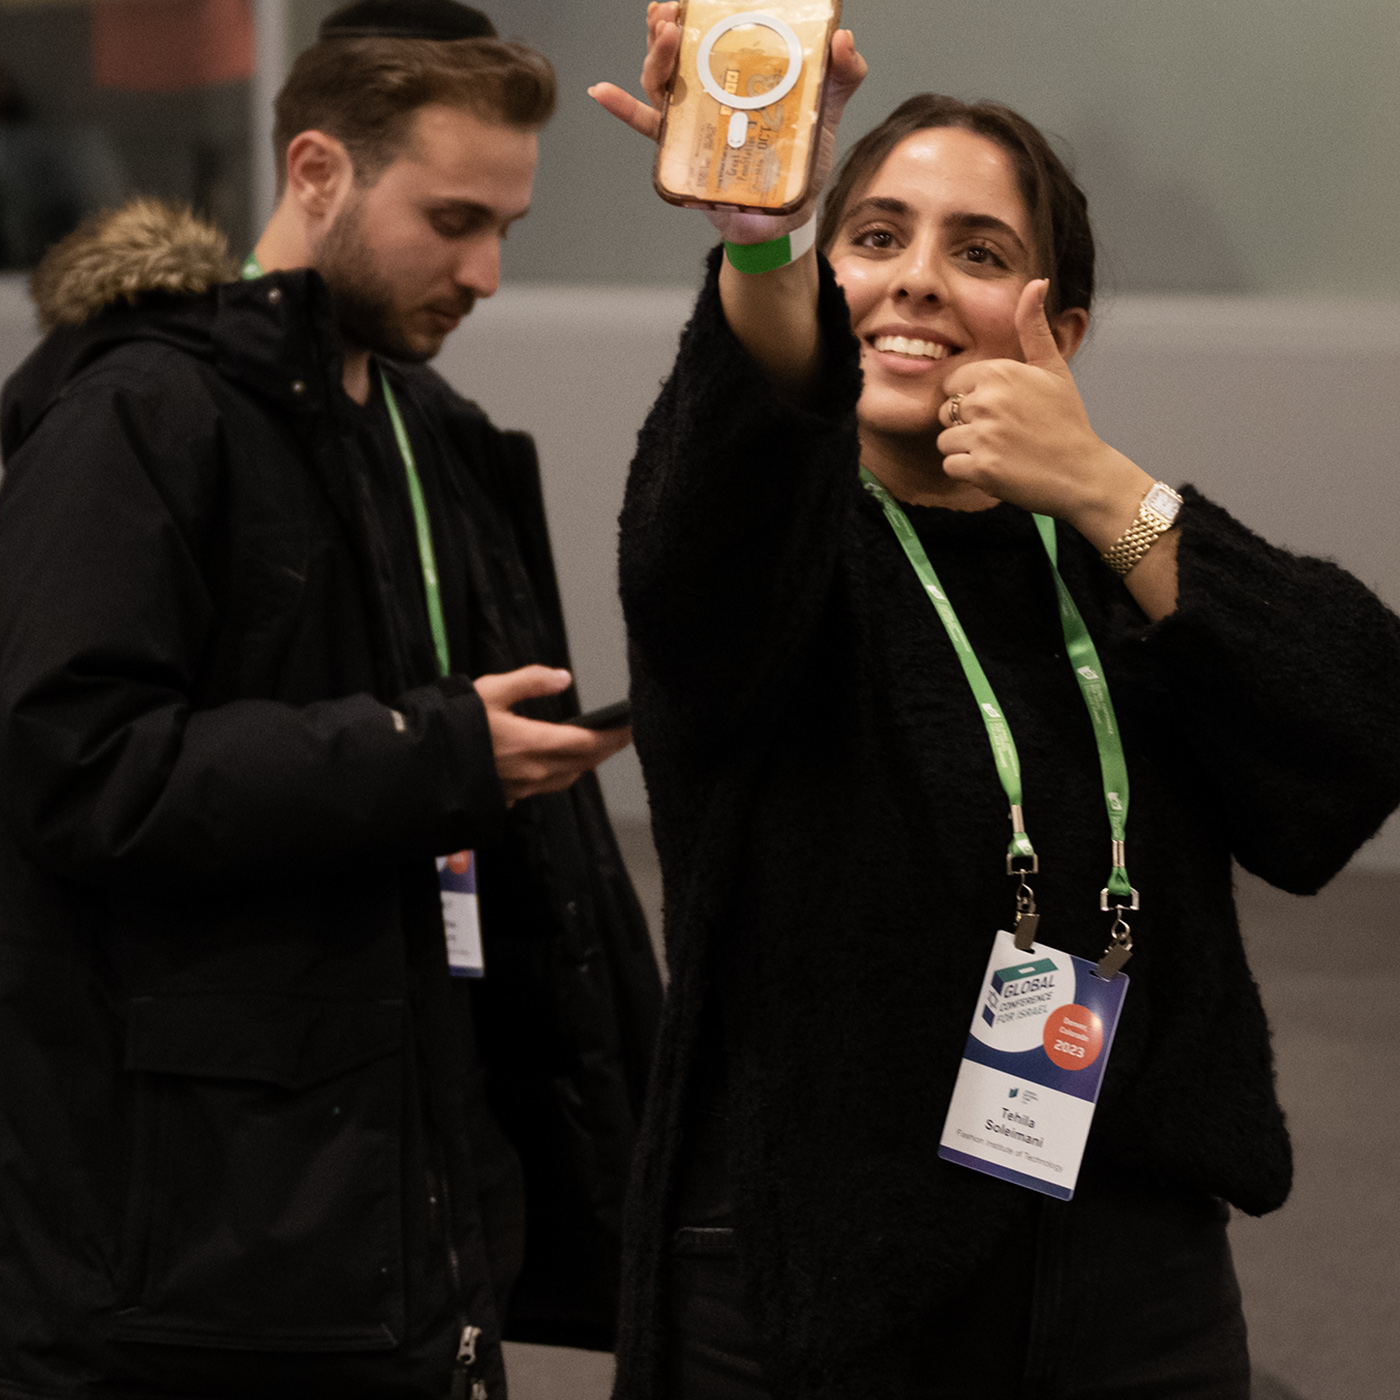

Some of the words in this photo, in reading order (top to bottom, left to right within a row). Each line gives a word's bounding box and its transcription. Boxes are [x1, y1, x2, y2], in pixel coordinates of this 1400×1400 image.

[1004, 975, 1055, 998] GLOBAL
[1053, 1039, 1085, 1059] 2023
[1001, 1106, 1035, 1129] Tehilla
[984, 1119, 1044, 1148] Soleimani
